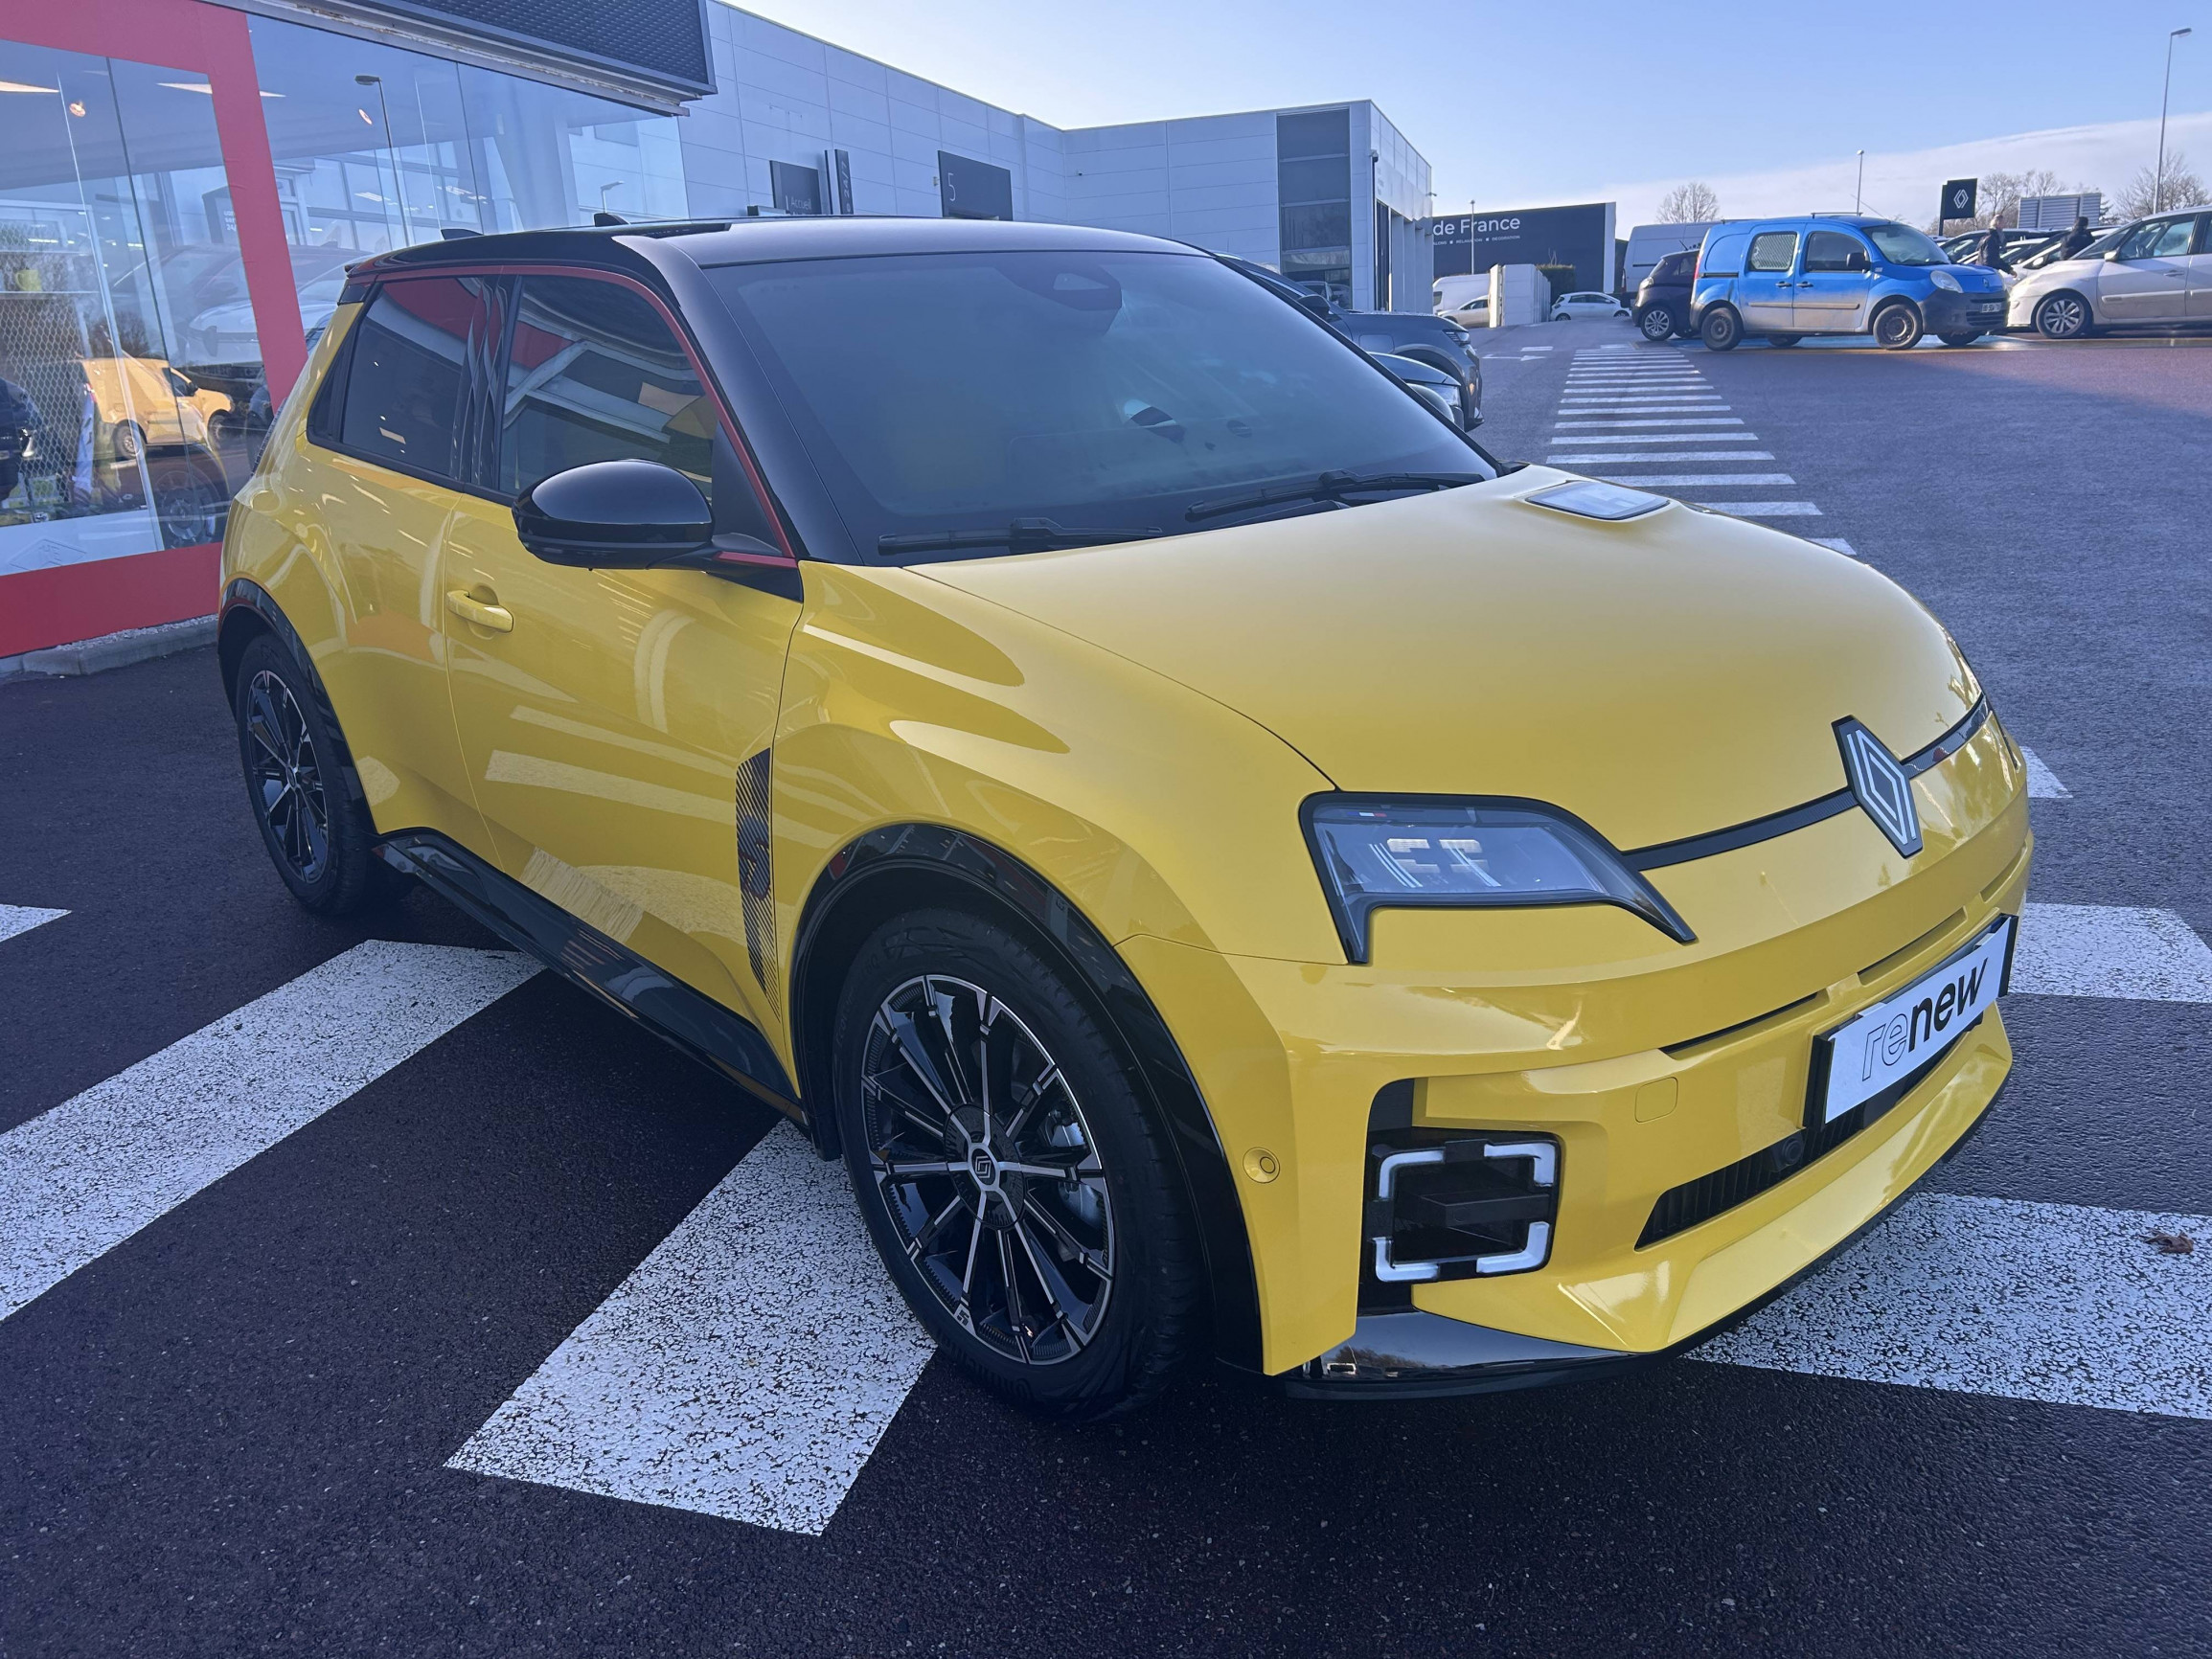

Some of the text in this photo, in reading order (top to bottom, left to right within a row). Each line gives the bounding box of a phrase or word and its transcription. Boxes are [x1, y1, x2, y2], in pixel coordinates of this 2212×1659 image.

[948, 172, 956, 202] 5
[1432, 217, 1521, 236] de France
[1862, 957, 1989, 1082] renew
